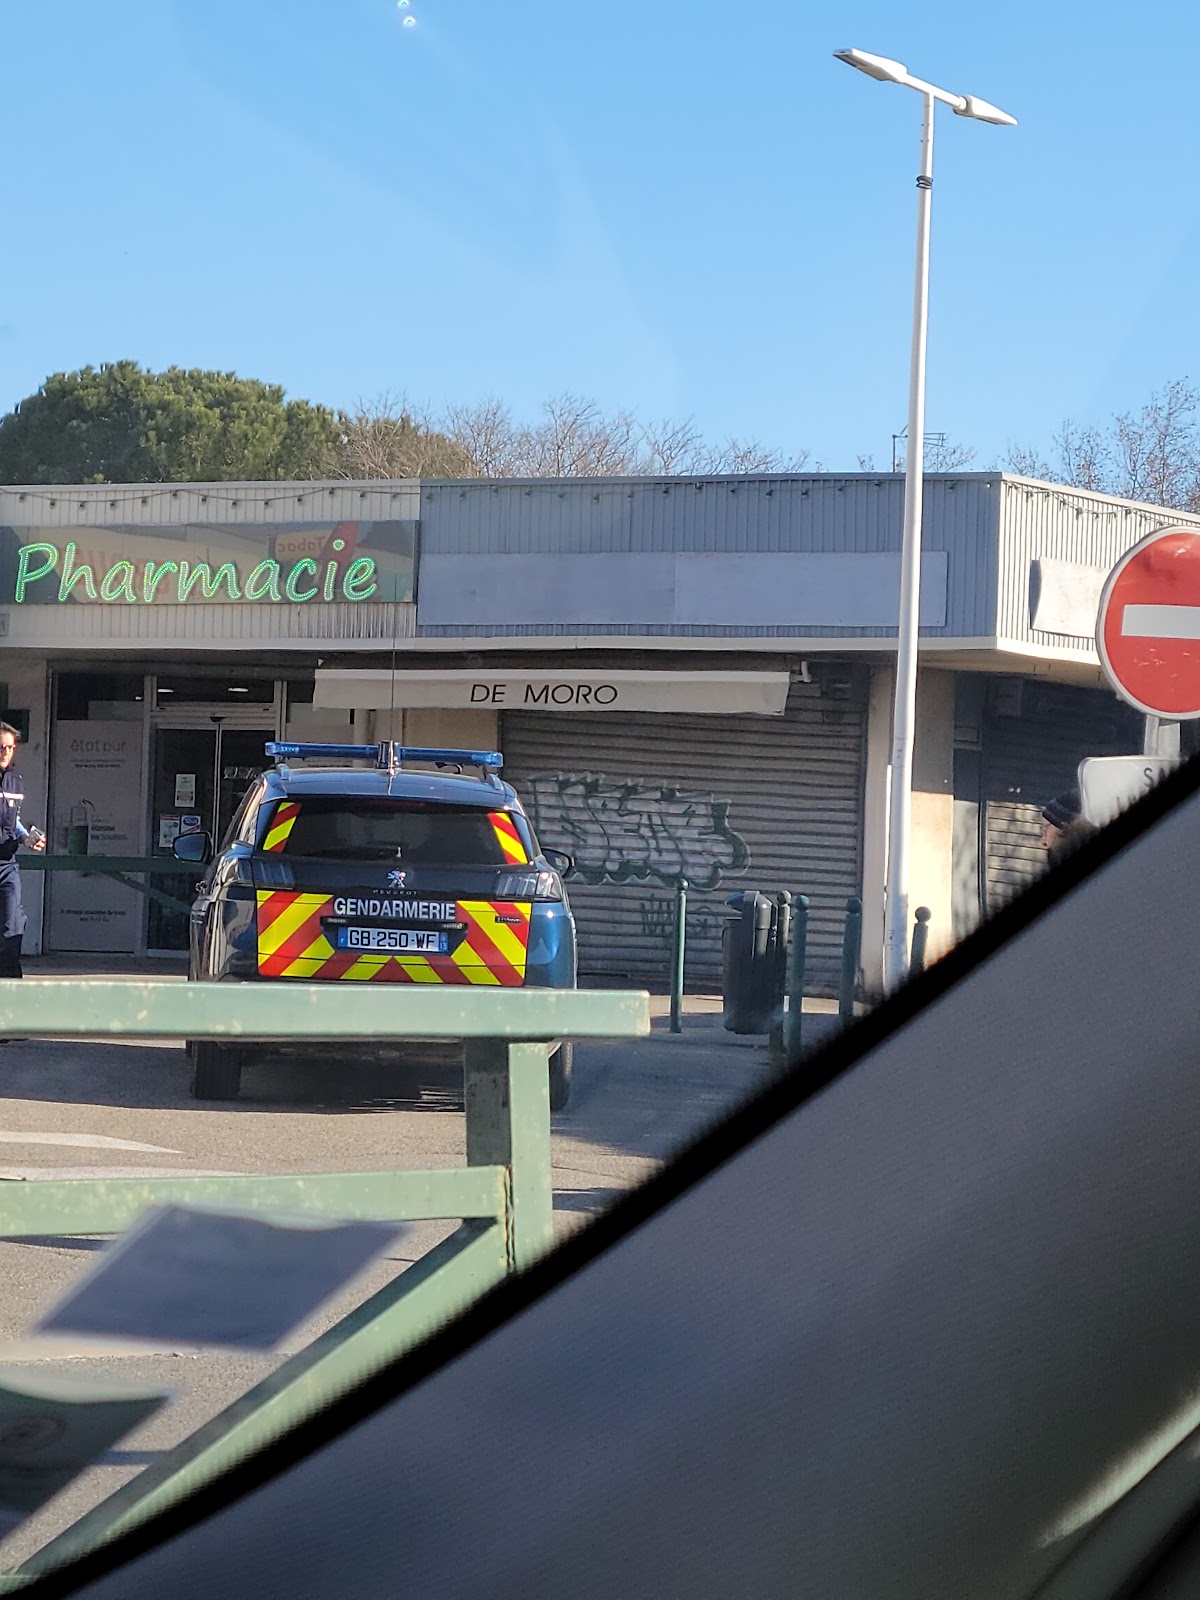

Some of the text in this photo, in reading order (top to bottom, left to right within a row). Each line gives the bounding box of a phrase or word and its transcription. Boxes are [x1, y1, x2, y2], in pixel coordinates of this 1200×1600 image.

[15, 539, 378, 603] Pharmacie
[470, 684, 618, 704] DE MORO
[333, 898, 456, 920] GENDARMERIE
[349, 930, 437, 950] GB-250-WF
